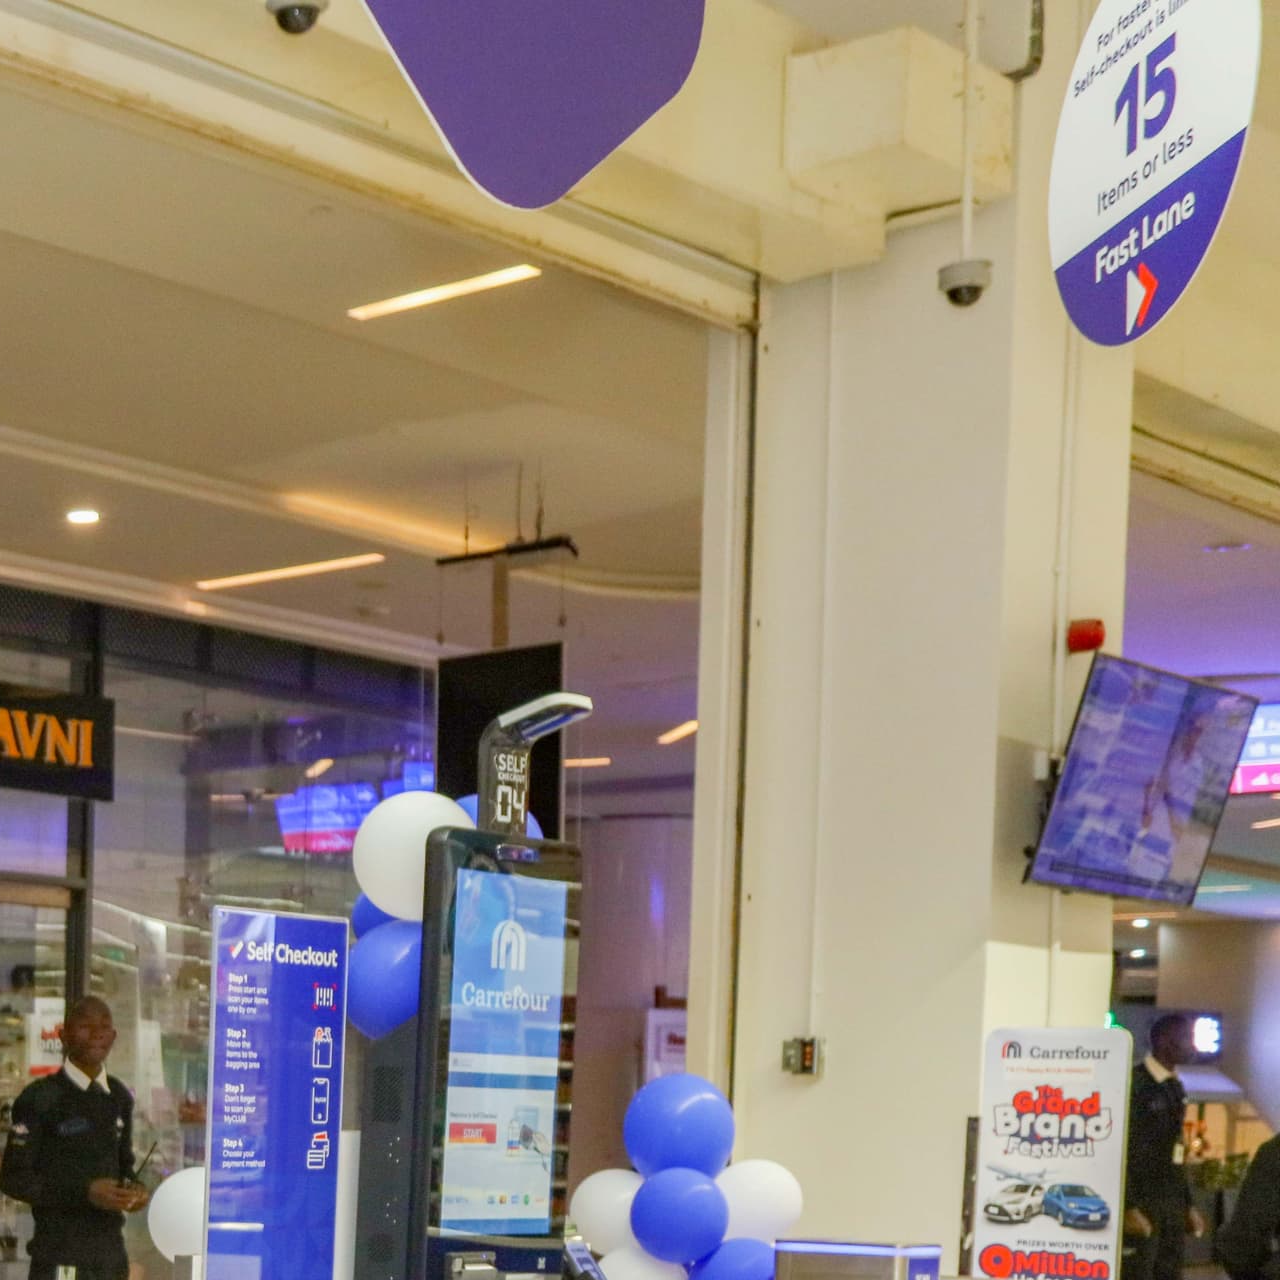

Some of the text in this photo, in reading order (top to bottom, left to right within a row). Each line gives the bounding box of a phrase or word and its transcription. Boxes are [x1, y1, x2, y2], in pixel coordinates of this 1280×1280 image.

[1096, 28, 1114, 53] For
[1074, 22, 1153, 98] Self-checkout
[1114, 32, 1176, 156] 15
[1097, 127, 1193, 215] Items or less
[1095, 192, 1195, 283] Fast Lane
[498, 754, 526, 773] SELF
[496, 785, 525, 823] 04
[247, 941, 338, 967] Self Checkout
[229, 973, 242, 984] Step
[461, 981, 550, 1012] Carrefour
[227, 1028, 240, 1039] Step
[1030, 1046, 1109, 1060] Carrefour
[225, 1083, 244, 1094] Step 3
[1036, 1084, 1062, 1098] The
[1013, 1091, 1101, 1117] Grand
[993, 1105, 1112, 1141] Brand
[223, 1138, 242, 1149] Step 4
[1008, 1136, 1095, 1158] Festival
[1017, 1239, 1109, 1250] PRIZES WORTH OVER
[1016, 1249, 1109, 1280] Million
